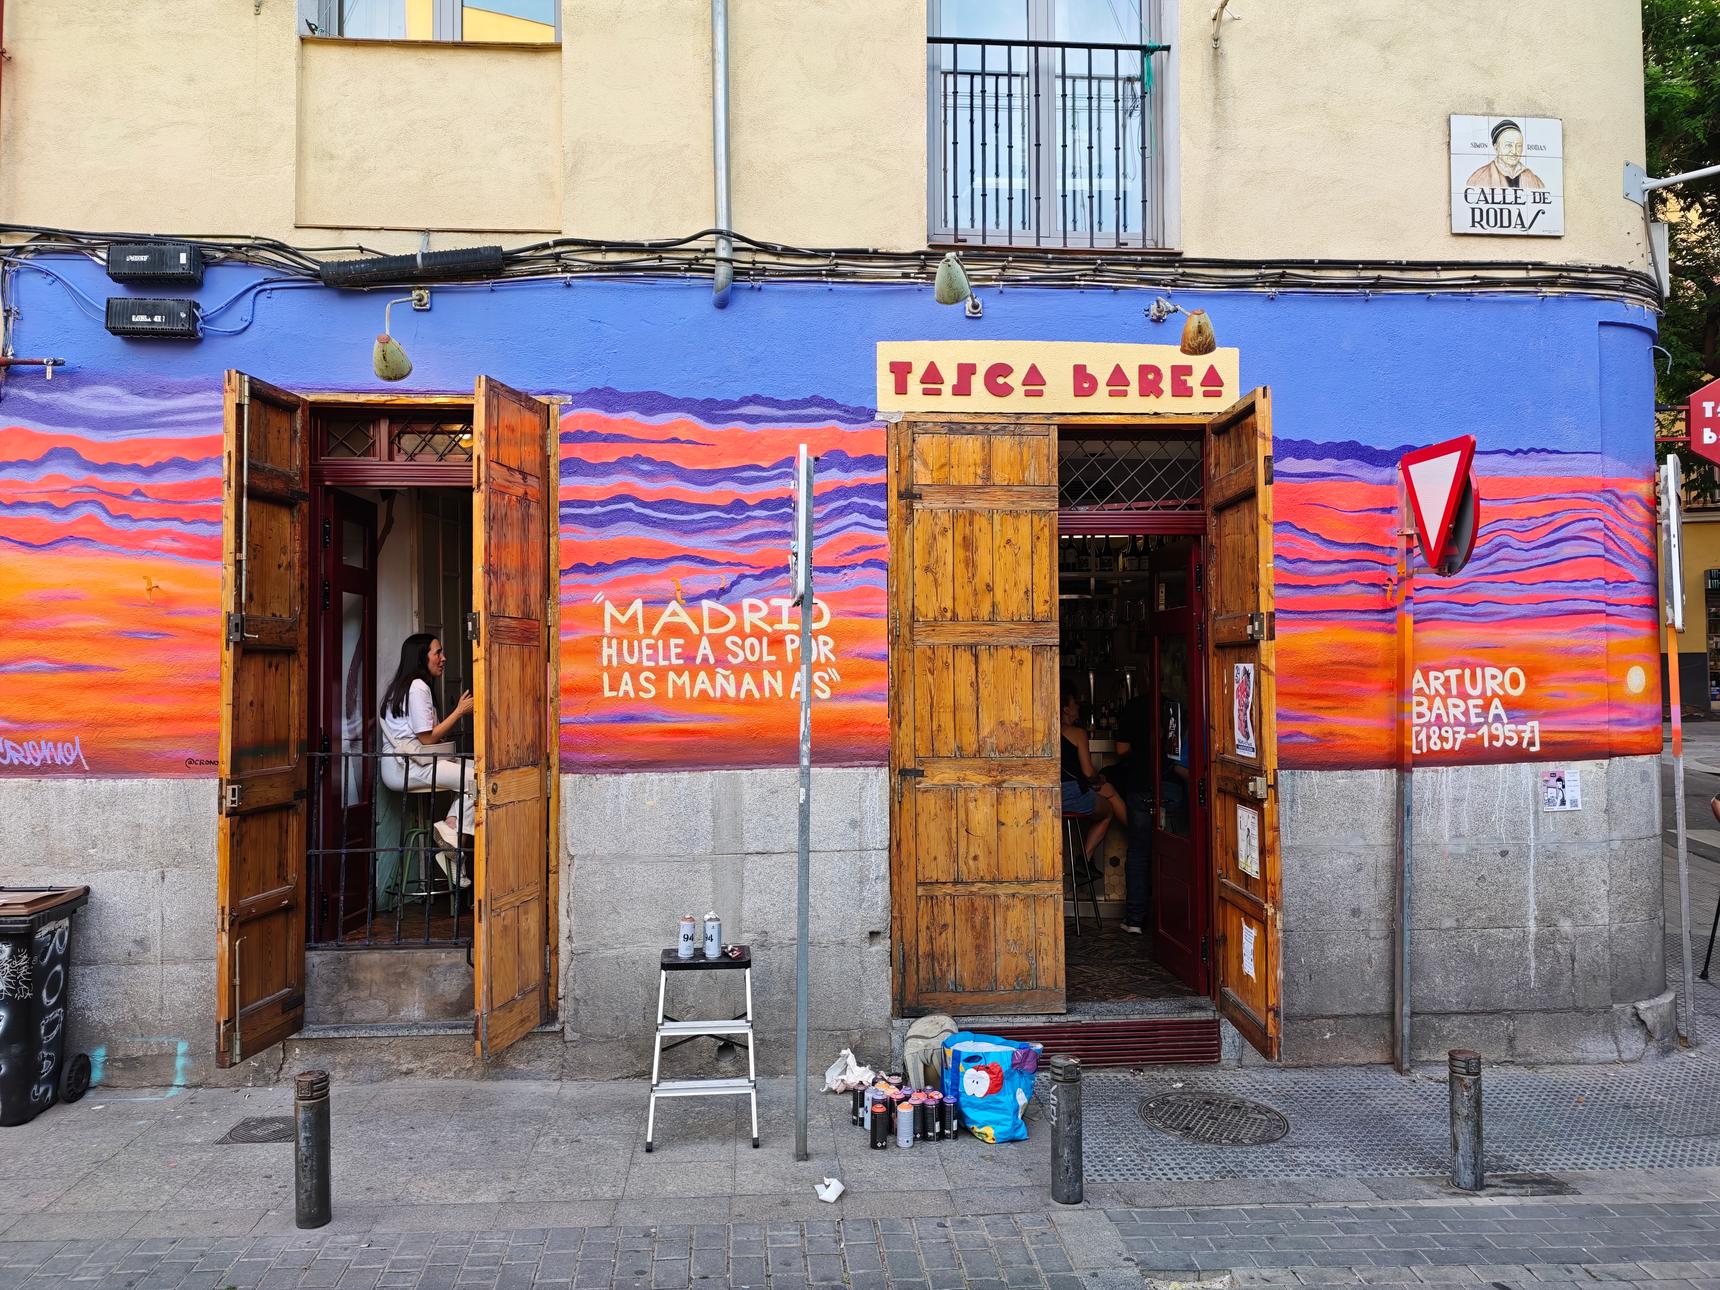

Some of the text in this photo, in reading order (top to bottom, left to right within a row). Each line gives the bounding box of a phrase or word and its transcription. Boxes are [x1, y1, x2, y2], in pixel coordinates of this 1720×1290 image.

[1464, 187, 1552, 205] CALLE DE
[1469, 207, 1546, 232] RODAS
[889, 360, 1047, 397] TASCA
[1702, 401, 1720, 418] T
[601, 636, 685, 667] HUELE
[696, 637, 716, 665] A
[725, 635, 776, 665] SOL
[602, 670, 657, 698] LAS
[1411, 666, 1526, 696] ARTURO
[1411, 696, 1508, 725] BAREA
